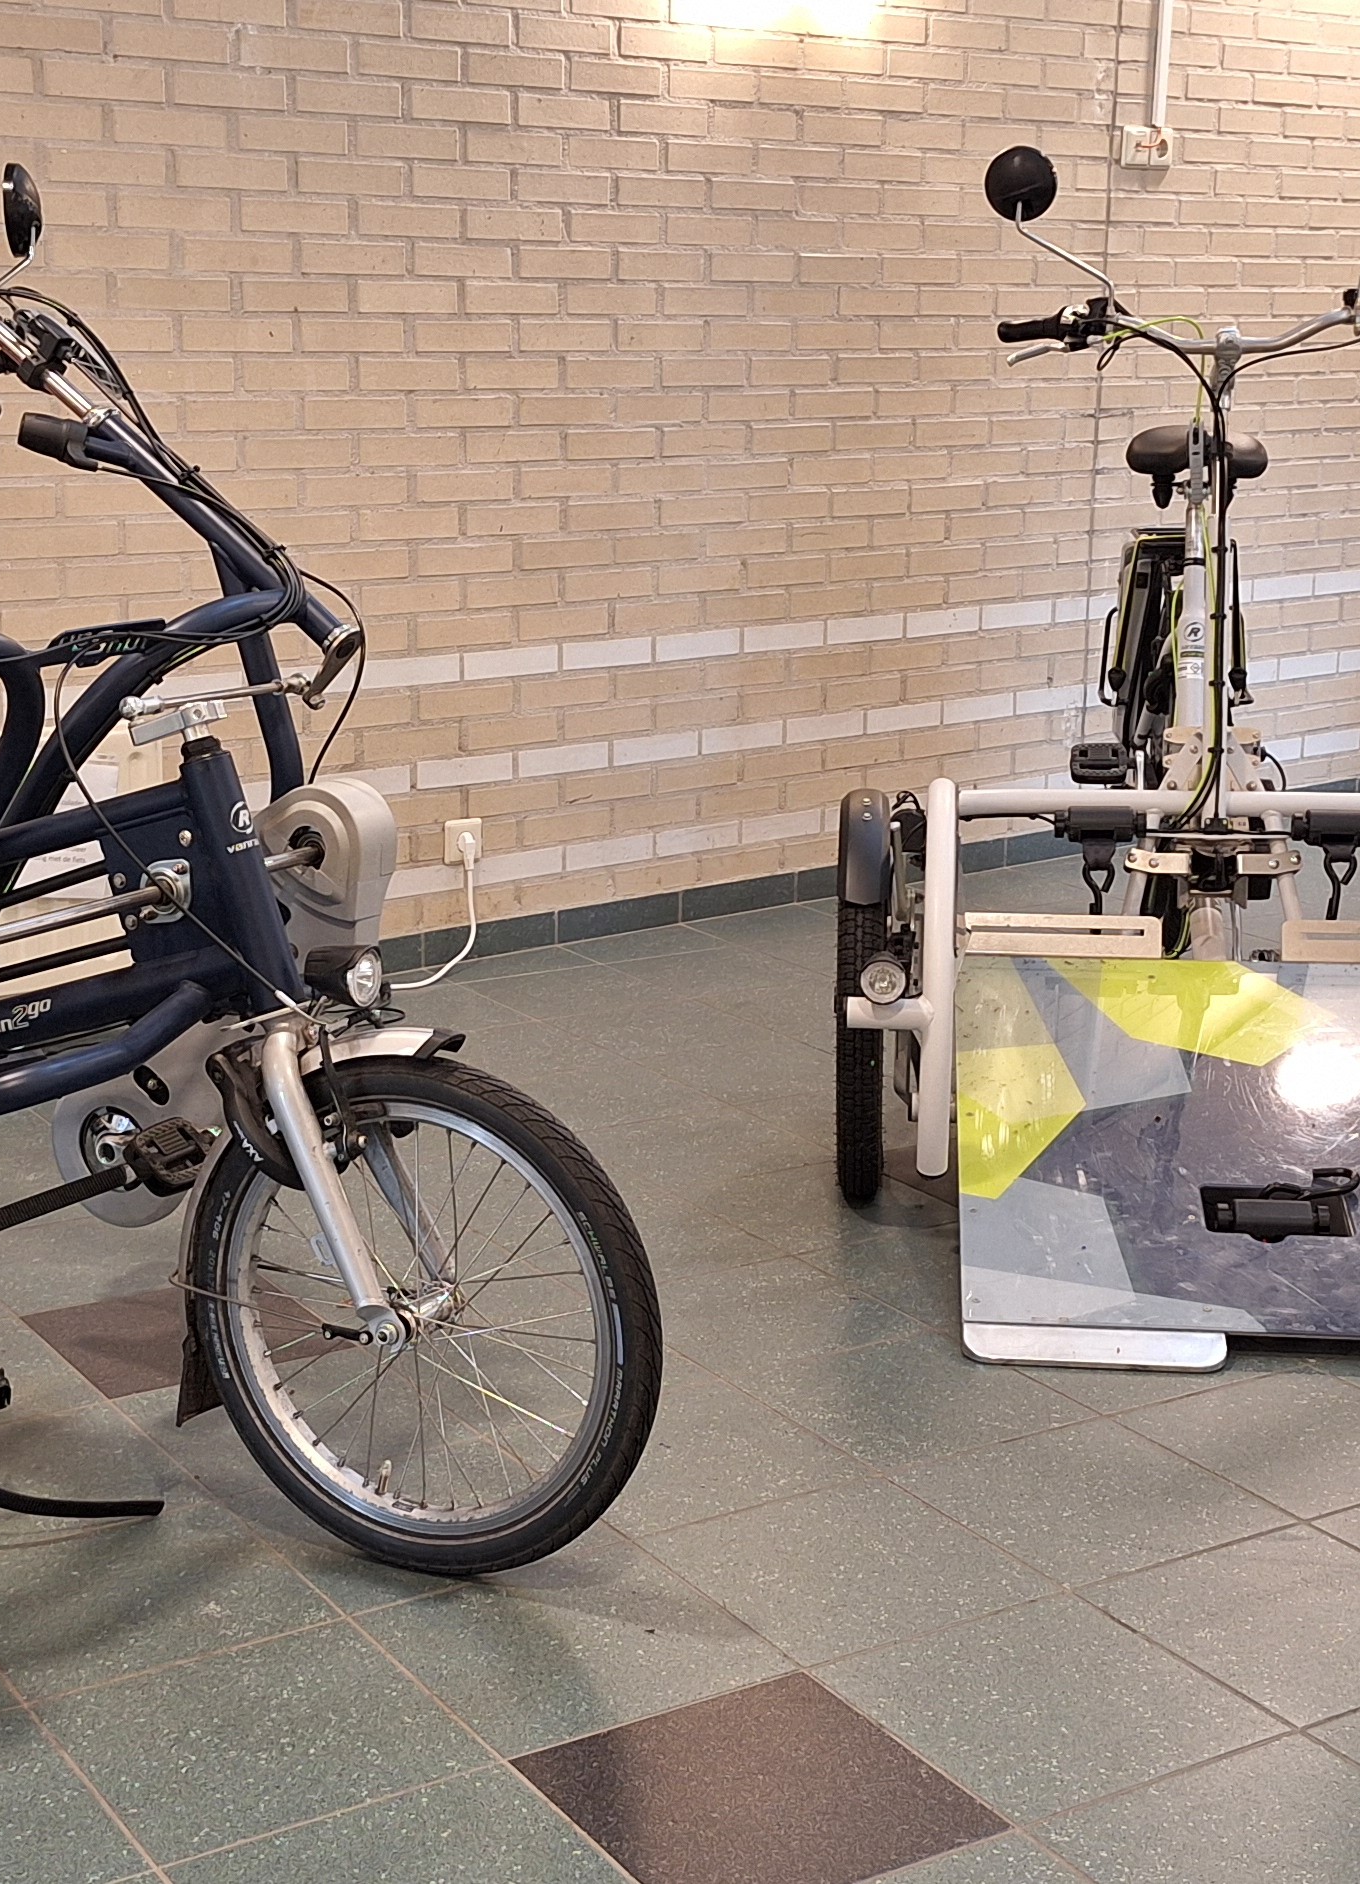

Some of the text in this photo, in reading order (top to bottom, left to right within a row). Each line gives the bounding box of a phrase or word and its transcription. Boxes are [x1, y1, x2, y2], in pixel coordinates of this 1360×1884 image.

[1187, 627, 1201, 638] R
[238, 809, 251, 828] R
[241, 1138, 265, 1162] AXA
[580, 1367, 624, 1487] MARATHON PLUS
